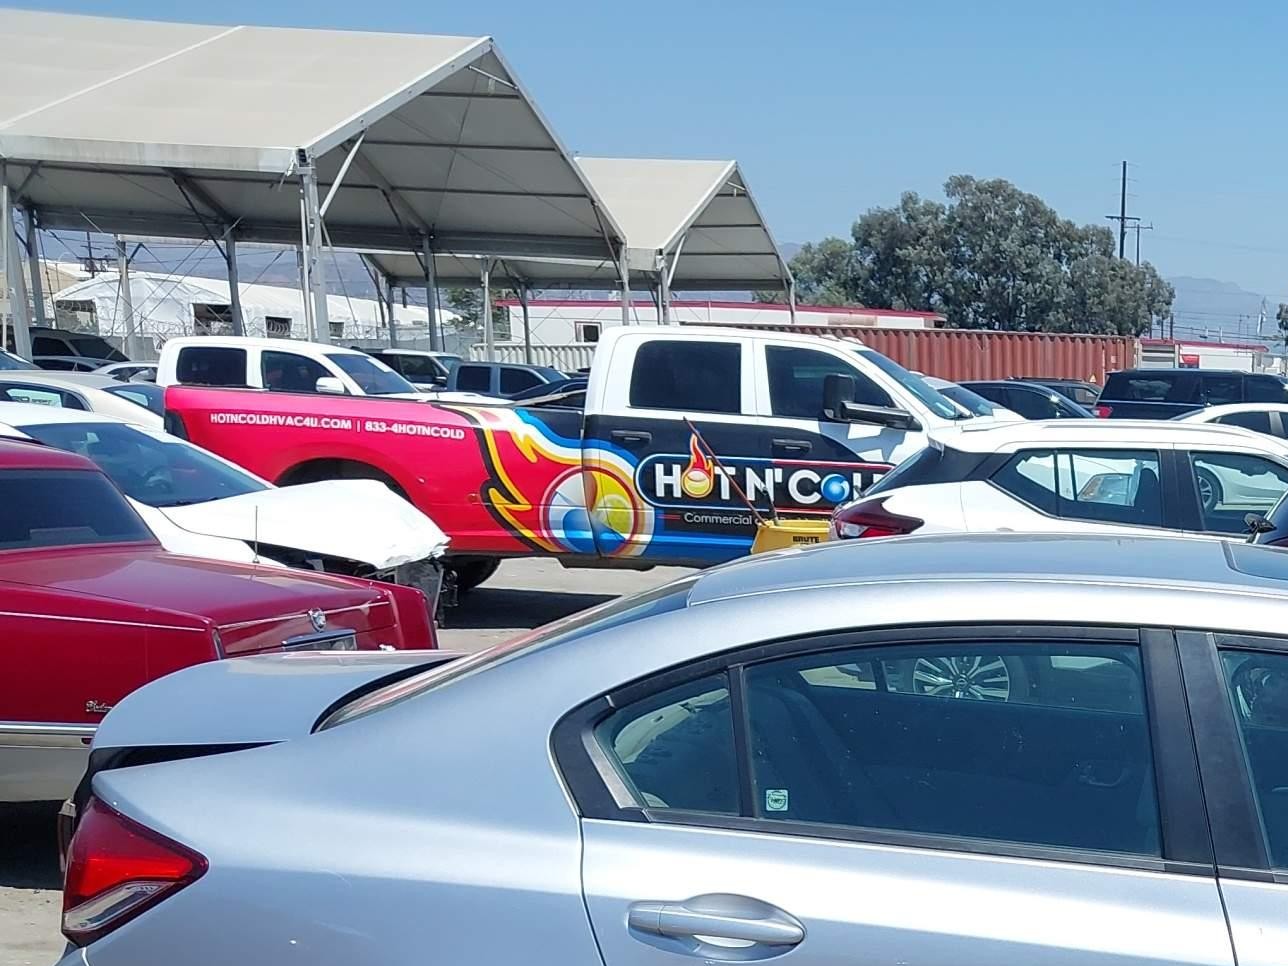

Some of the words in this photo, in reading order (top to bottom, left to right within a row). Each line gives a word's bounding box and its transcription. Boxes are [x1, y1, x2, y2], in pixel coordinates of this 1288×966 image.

[210, 413, 352, 430] HOTNCOLDHVAC4U.COM
[364, 420, 465, 440] 833-4HOTNCOLD
[683, 511, 753, 526] Commercial
[792, 535, 820, 544] BRUTE
